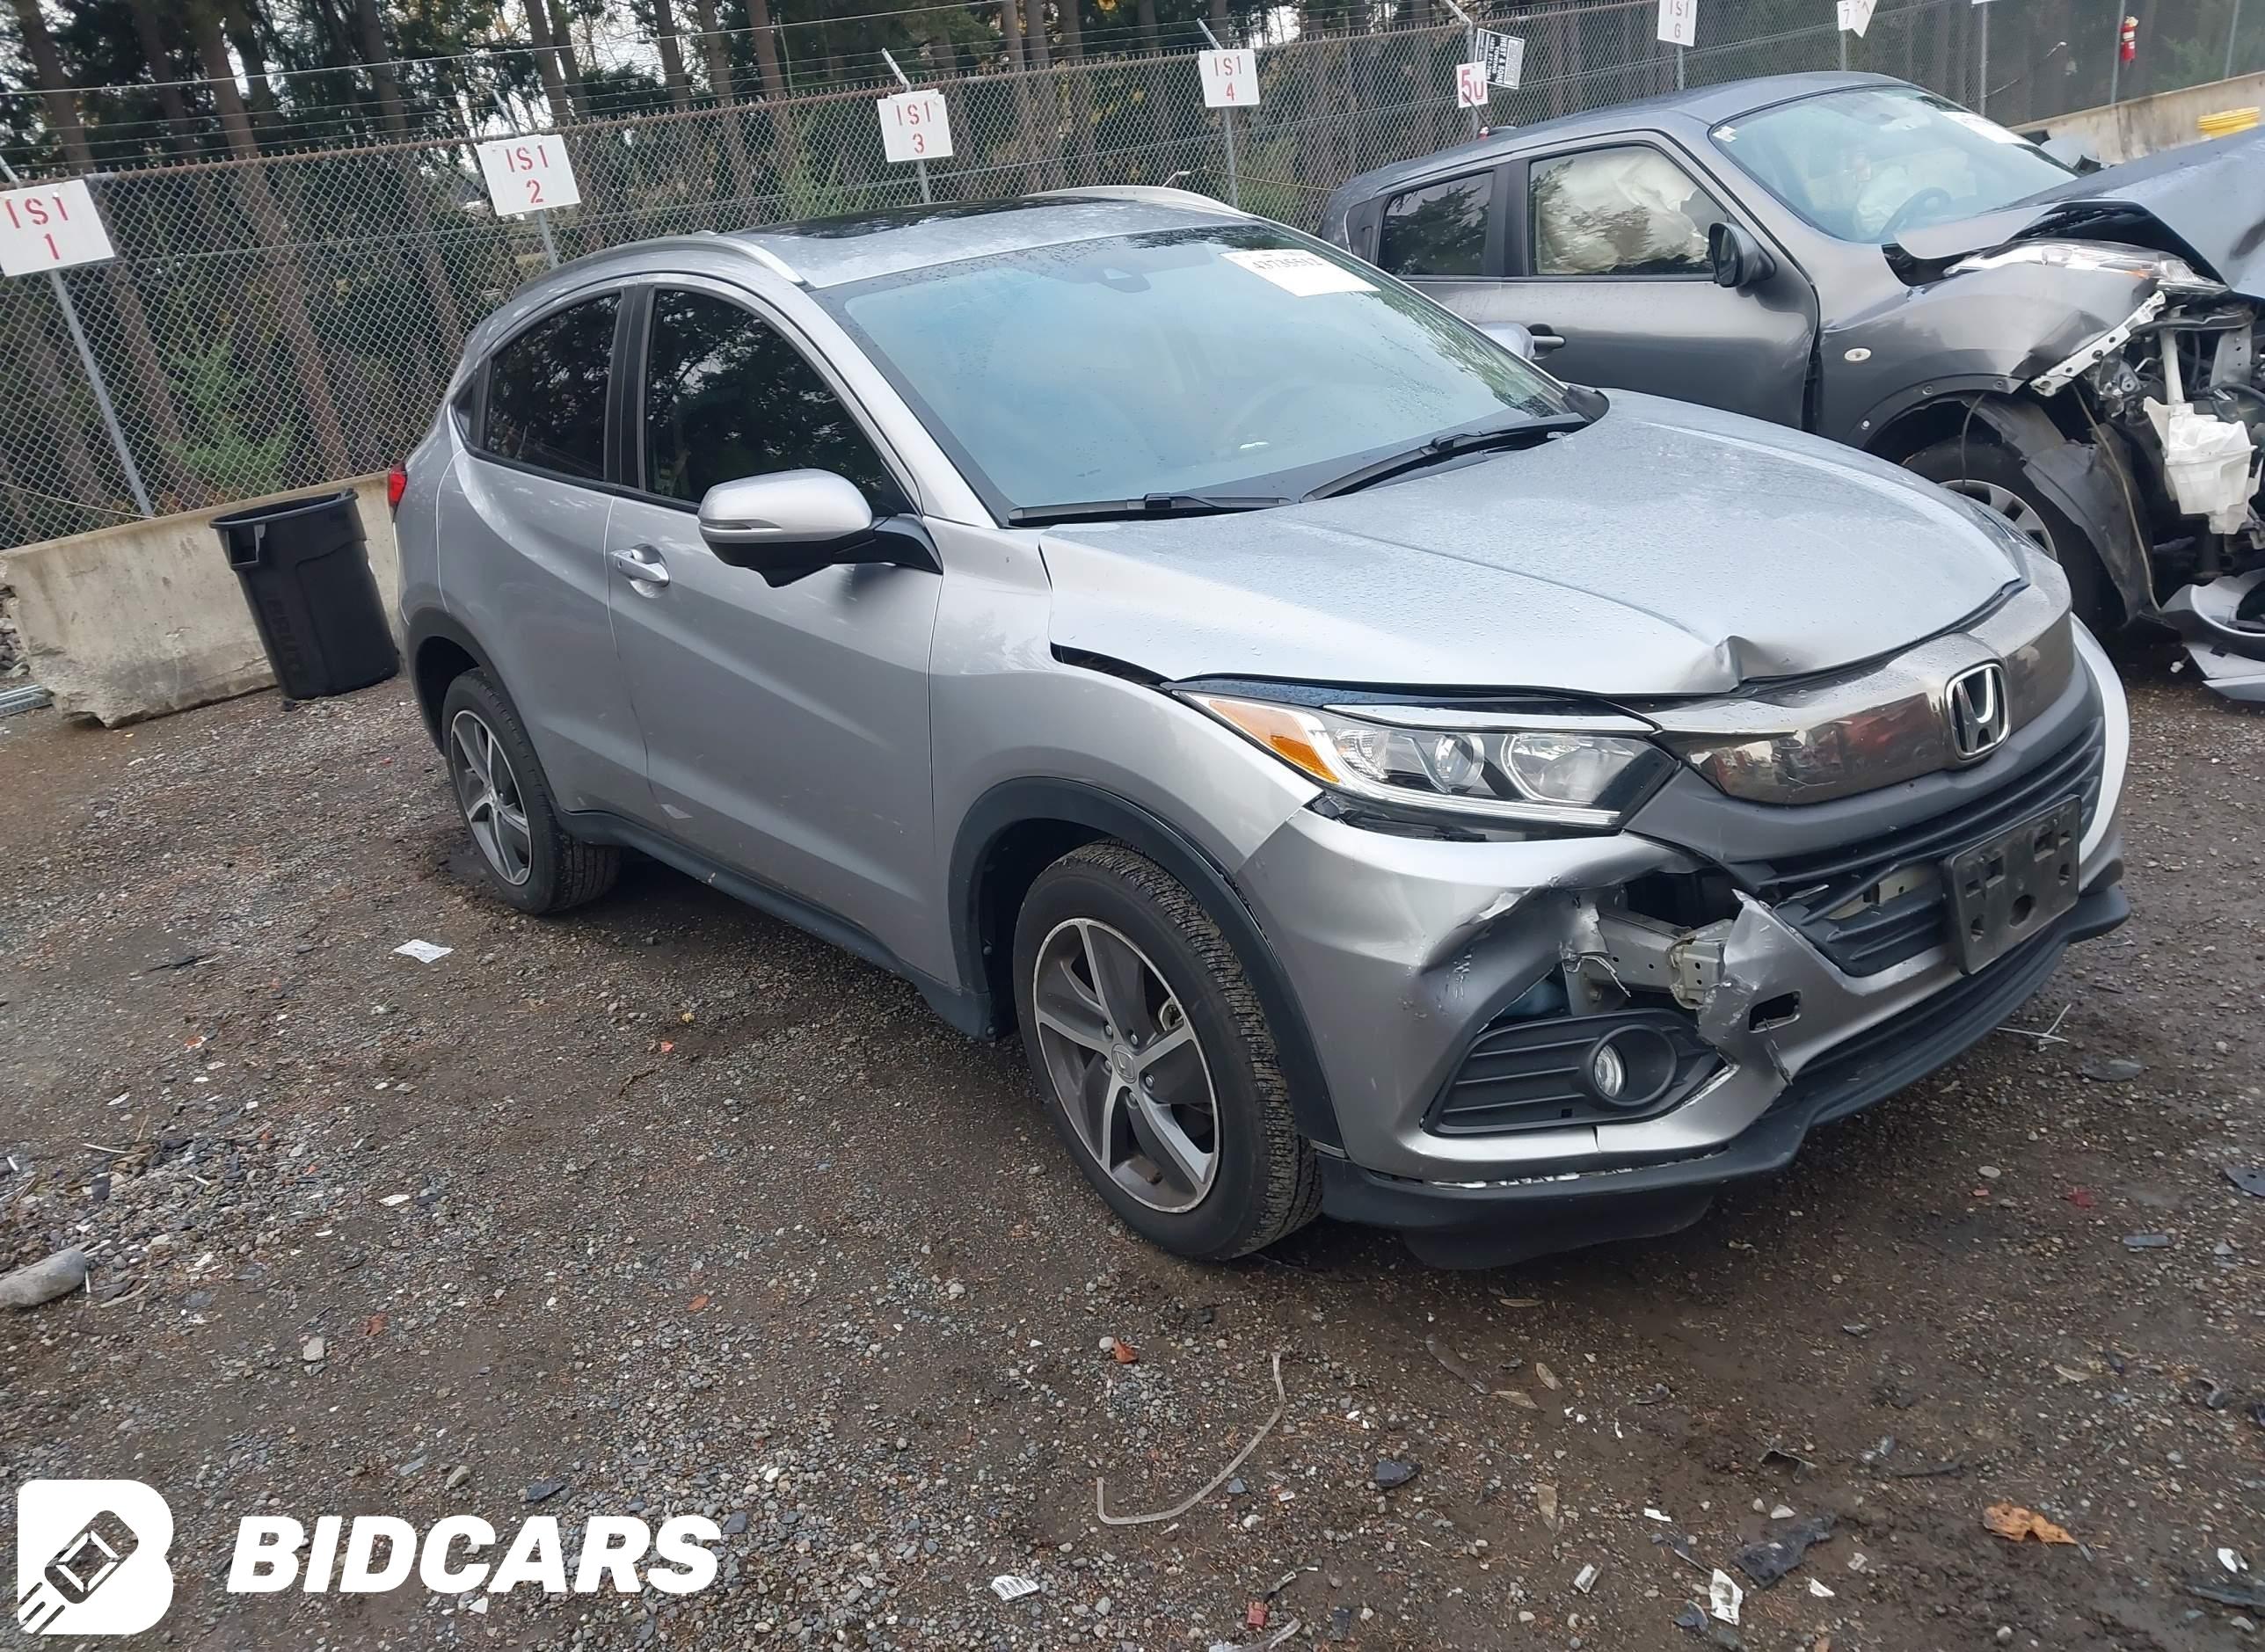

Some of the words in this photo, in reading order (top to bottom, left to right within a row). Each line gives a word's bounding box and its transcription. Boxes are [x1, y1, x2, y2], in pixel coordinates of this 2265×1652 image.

[1226, 82, 1234, 101] 4
[913, 133, 925, 154] 3
[526, 179, 544, 204] 2
